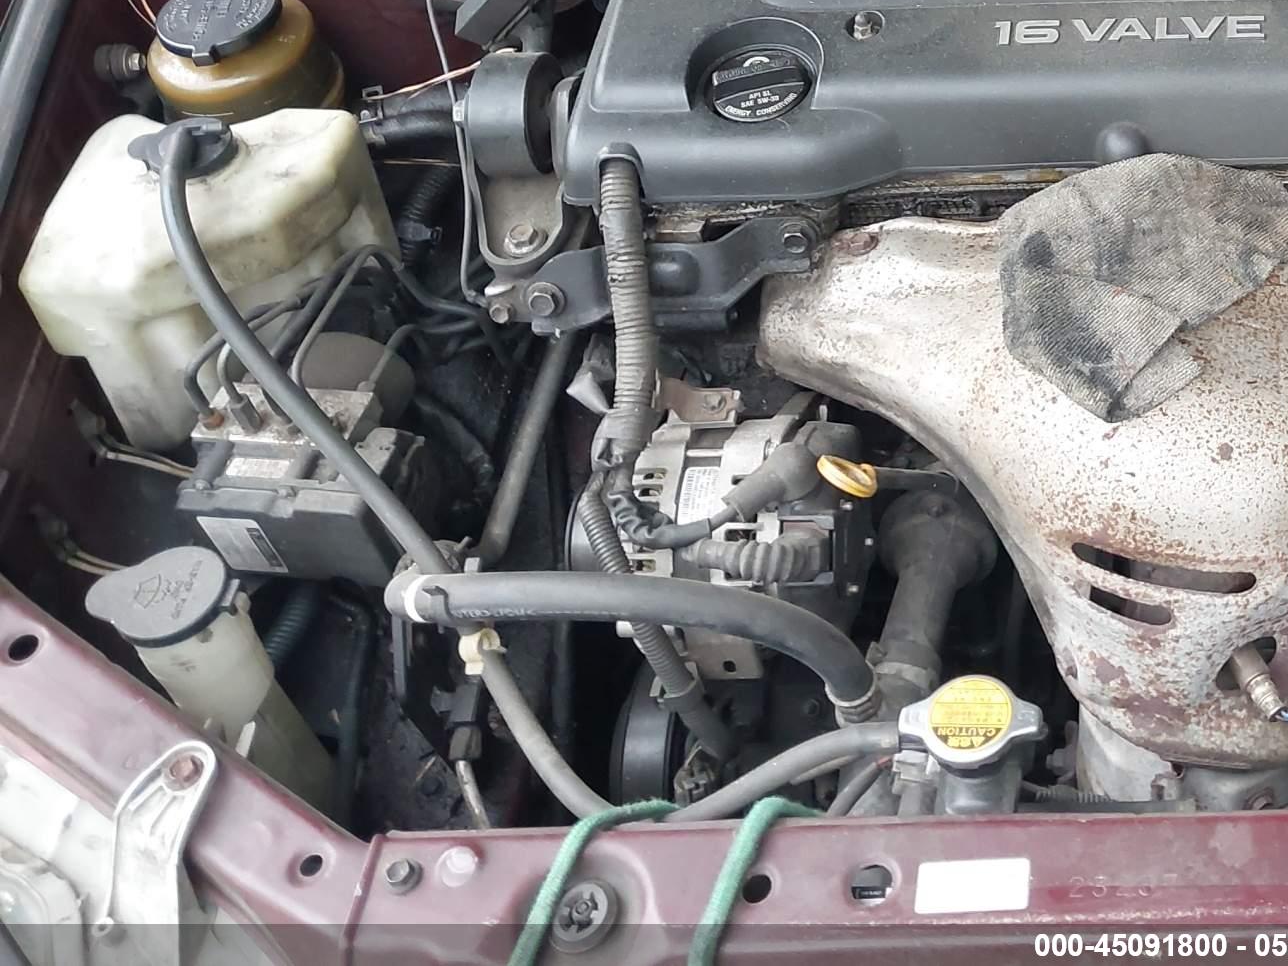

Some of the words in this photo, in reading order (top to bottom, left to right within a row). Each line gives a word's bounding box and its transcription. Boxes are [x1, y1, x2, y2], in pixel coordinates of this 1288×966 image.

[995, 18, 1063, 46] 16
[1072, 15, 1267, 43] VALVE
[740, 99, 755, 108] SAE
[937, 727, 996, 737] CAUTION
